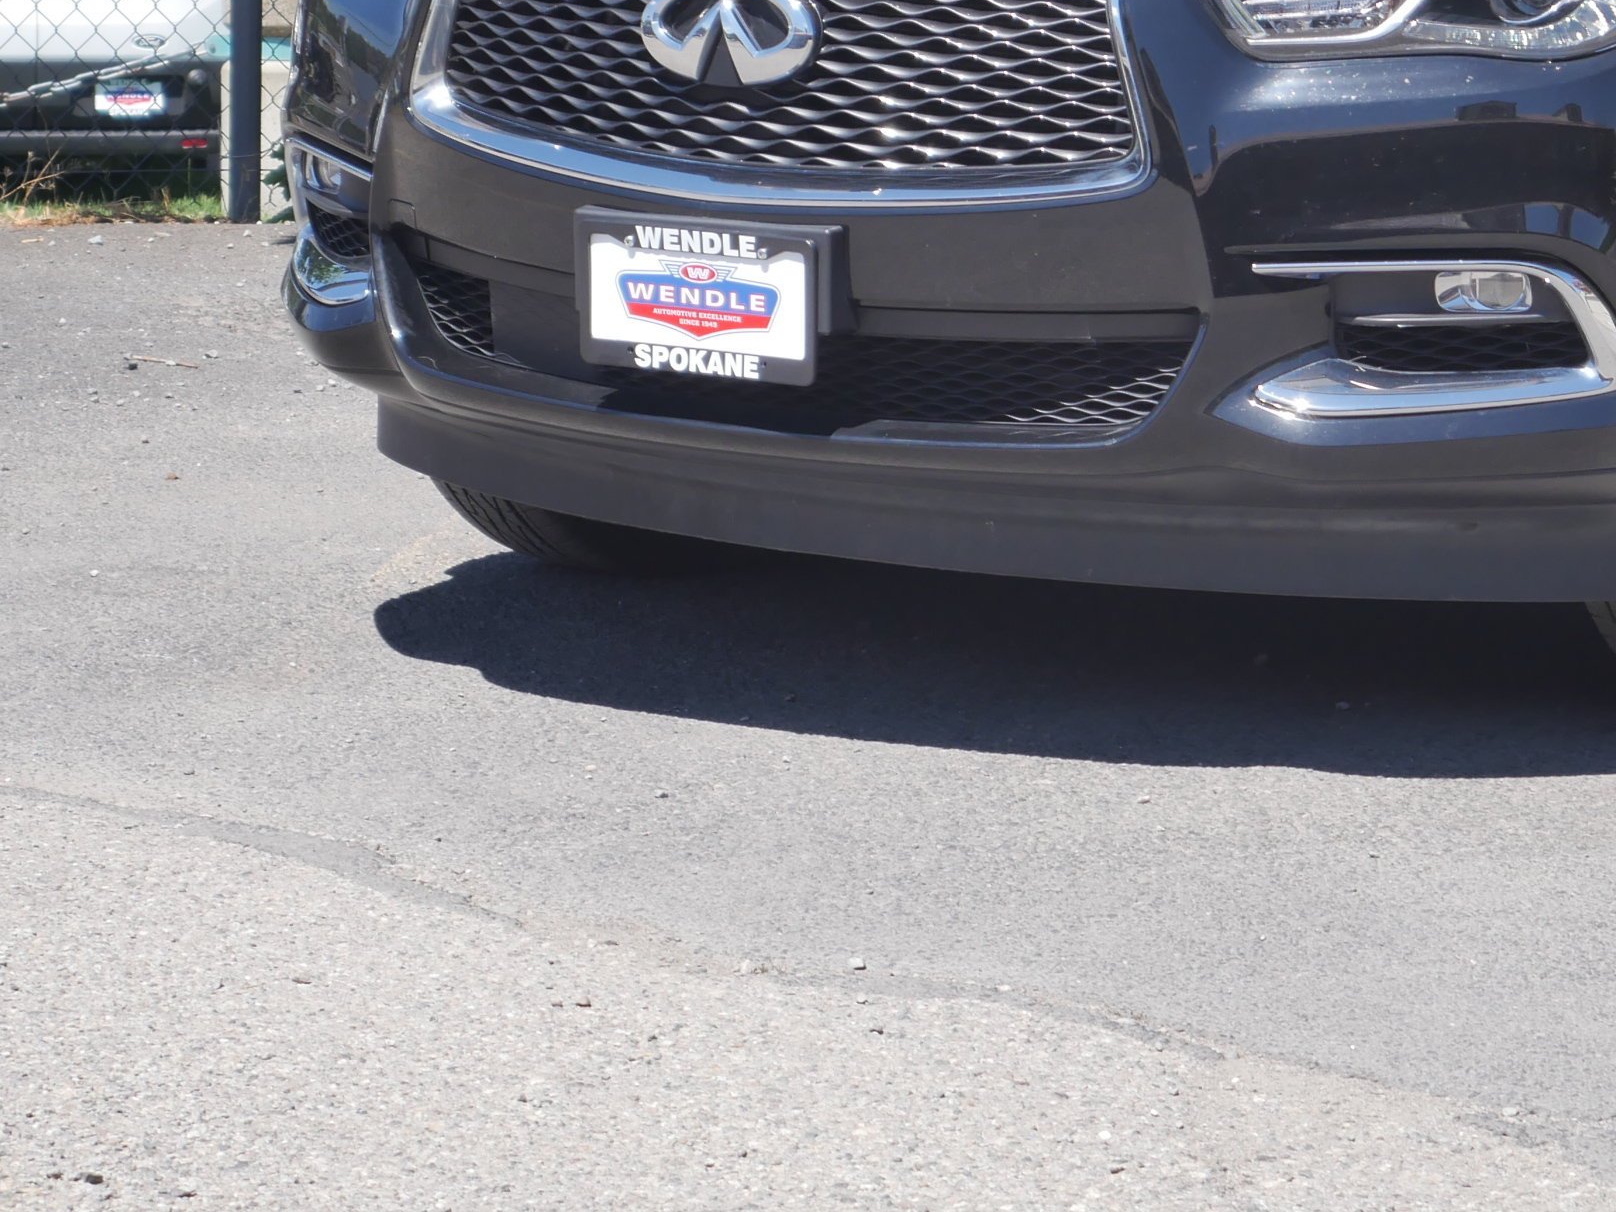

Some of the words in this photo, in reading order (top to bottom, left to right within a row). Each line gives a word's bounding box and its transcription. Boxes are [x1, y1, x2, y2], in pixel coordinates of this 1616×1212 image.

[635, 225, 757, 259] WENDLE
[627, 282, 765, 312] WENDLE
[653, 308, 697, 318] AUTOMOTIVE
[699, 312, 742, 323] EXCELLENCE
[679, 318, 700, 326] SINCE
[634, 343, 759, 379] SPOKANE
